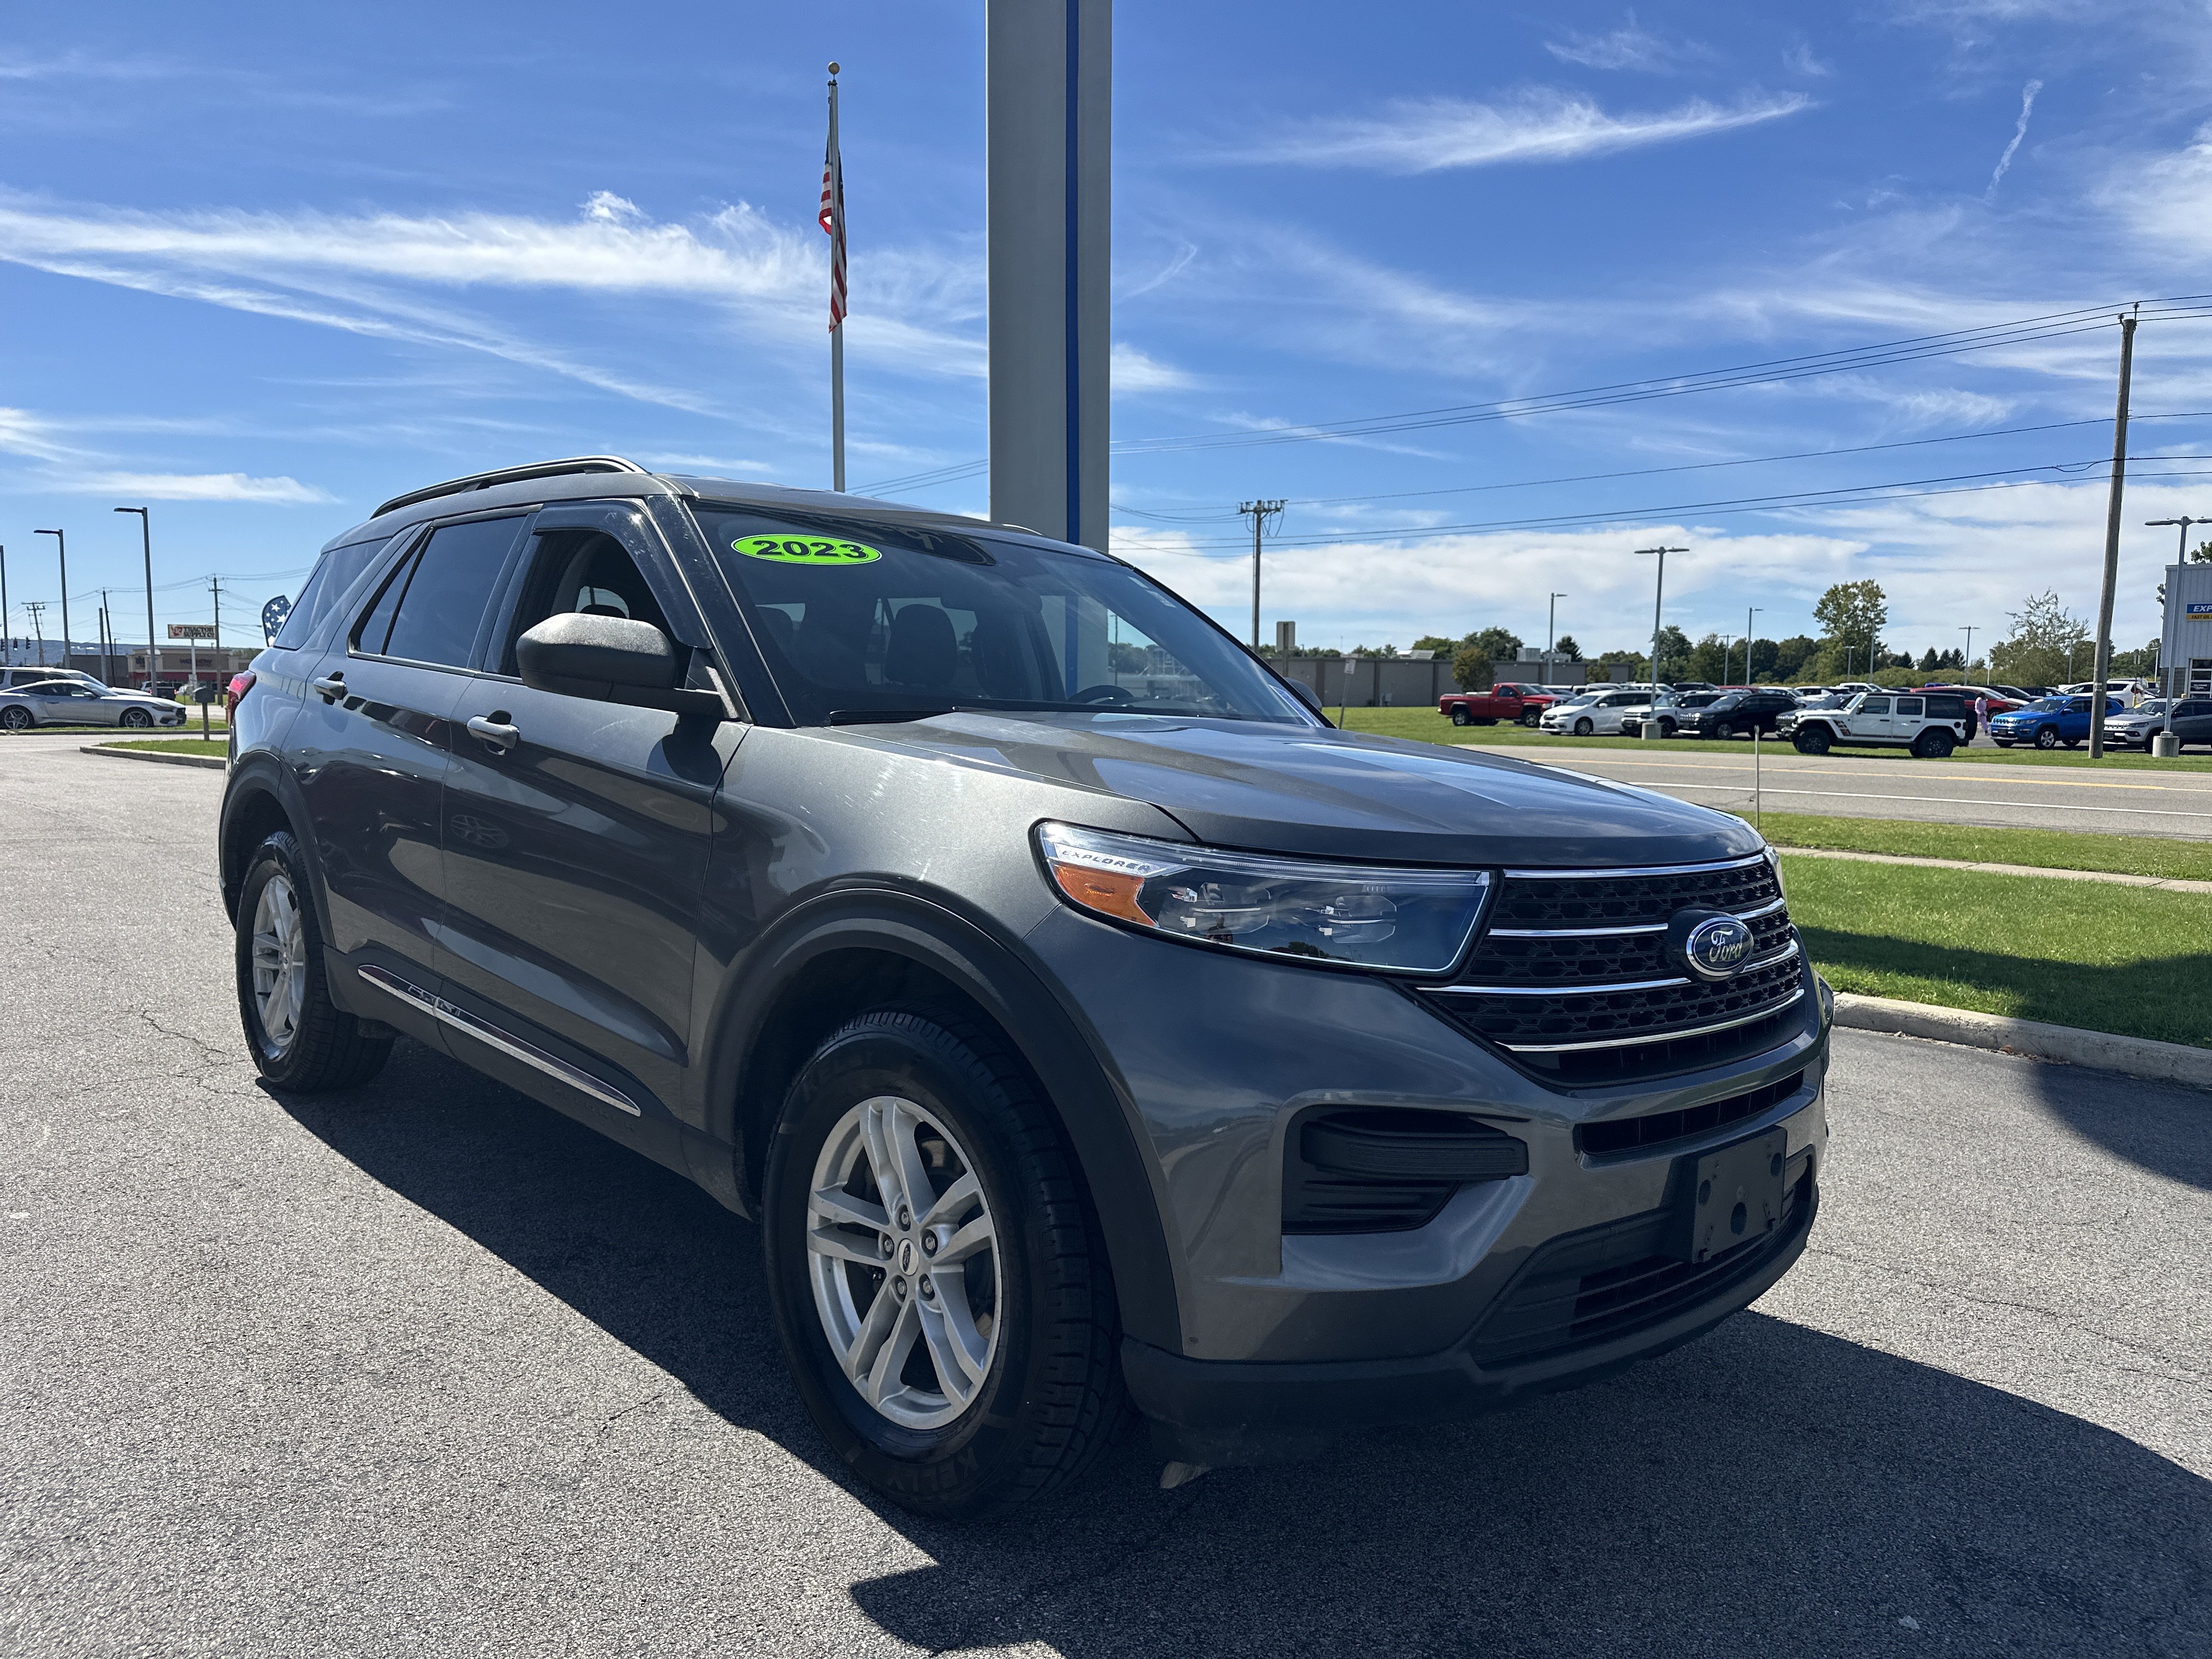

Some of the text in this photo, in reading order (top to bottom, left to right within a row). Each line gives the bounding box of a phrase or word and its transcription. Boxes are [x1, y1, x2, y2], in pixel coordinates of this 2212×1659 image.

[752, 540, 869, 560] 2023
[1062, 850, 1152, 873] EXPLORER
[1709, 929, 1743, 963] Ford
[885, 1446, 980, 1492] KELLY
